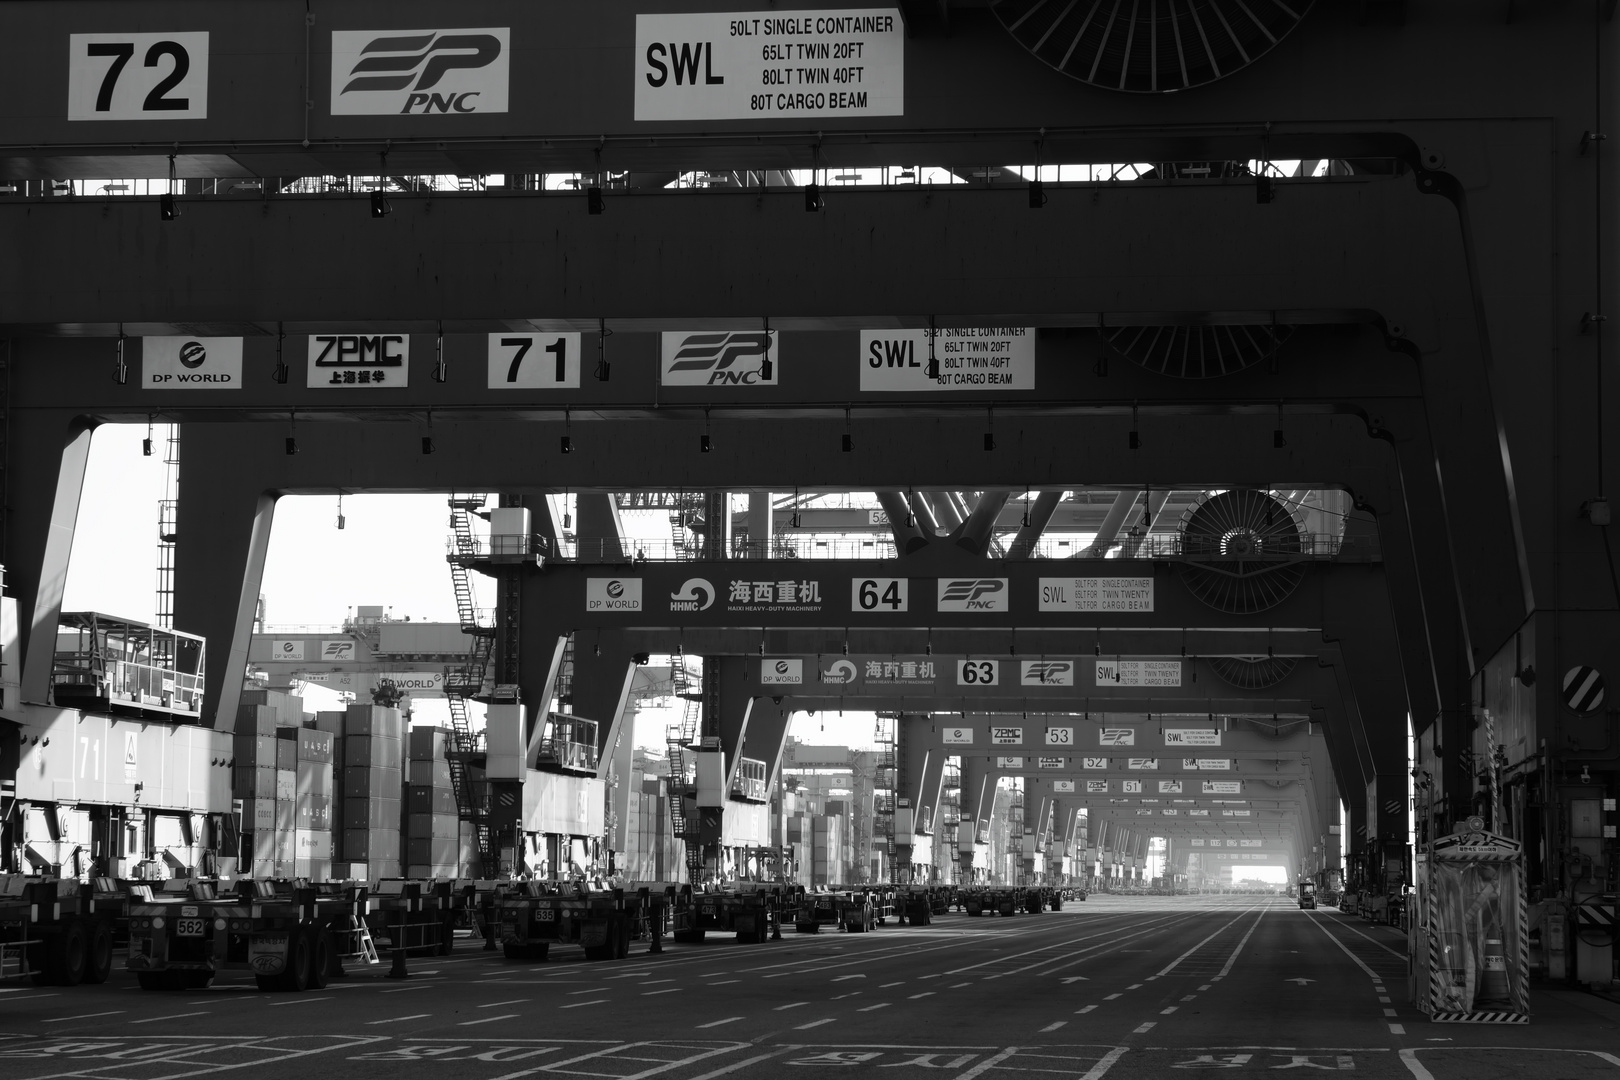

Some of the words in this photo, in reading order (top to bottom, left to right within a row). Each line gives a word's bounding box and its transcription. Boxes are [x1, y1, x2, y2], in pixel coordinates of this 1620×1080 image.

[730, 20, 760, 37] 50LT
[763, 18, 812, 36] SINGLE
[816, 16, 894, 35] CONTAINER
[762, 44, 793, 61] 65LT
[797, 43, 829, 60] TWIN
[833, 42, 865, 59] 20FT
[646, 42, 725, 88] SWL
[87, 40, 190, 112] 72
[762, 69, 793, 86] 80LT
[797, 68, 829, 85] TWIN
[833, 67, 865, 84] 40FT
[400, 92, 481, 114] PNC
[751, 94, 774, 111] 80T
[777, 92, 826, 110] CARGO
[829, 91, 868, 109] BEAM
[946, 328, 976, 338] SINGLE
[979, 327, 1026, 337] CONTAINER
[315, 336, 403, 367] ZPMC
[944, 342, 965, 353] 65LT
[967, 342, 989, 352] TWIN
[990, 341, 1011, 352] 20FT
[501, 337, 566, 382] 71
[869, 339, 921, 369] SWL
[944, 358, 965, 369] 80LT
[967, 358, 989, 368] TWIN
[990, 356, 1011, 368] 40FT
[152, 374, 172, 383] DP
[177, 373, 232, 383] WORLD
[329, 371, 386, 385] 上海振华
[706, 371, 758, 385] PNC
[937, 374, 952, 385] 80T
[954, 373, 986, 385] CARGO
[988, 373, 1013, 384] BEAM
[1087, 580, 1098, 588] FOR
[1102, 580, 1120, 588] SINGLE
[1120, 580, 1150, 588] CONTAINER
[728, 579, 822, 603] 海西重机
[858, 580, 902, 610] 64
[1043, 586, 1067, 603] SWL
[1087, 590, 1098, 599] FOR
[1102, 590, 1119, 599] TWIN
[1120, 590, 1150, 599] TWENTY
[589, 600, 602, 609] DP
[605, 600, 640, 609] WORLD
[669, 601, 699, 611] HHMC
[966, 600, 996, 610] PNC
[1087, 601, 1098, 610] FOR
[1102, 601, 1126, 610] CARGO
[1129, 601, 1150, 610] BEAM
[864, 661, 937, 679] 海西重机
[962, 661, 994, 685] 63
[1098, 666, 1115, 680] SWL
[1144, 670, 1157, 678] TWIN
[1158, 670, 1180, 678] TWENTY
[397, 680, 435, 689] WORLD
[823, 677, 845, 685] HHMC
[1144, 678, 1162, 686] CARGO
[1163, 678, 1180, 686] BEAM
[994, 728, 1021, 738] ZPMC
[1050, 729, 1069, 744] 53
[1167, 732, 1183, 742] SWL
[80, 736, 100, 781] 71
[1087, 758, 1103, 768] 52
[1126, 782, 1137, 791] 51
[536, 911, 553, 920] 535
[703, 906, 716, 915] 473
[179, 921, 203, 934] 562
[782, 1051, 981, 1069] 정지
[1169, 1053, 1356, 1070] 정지
